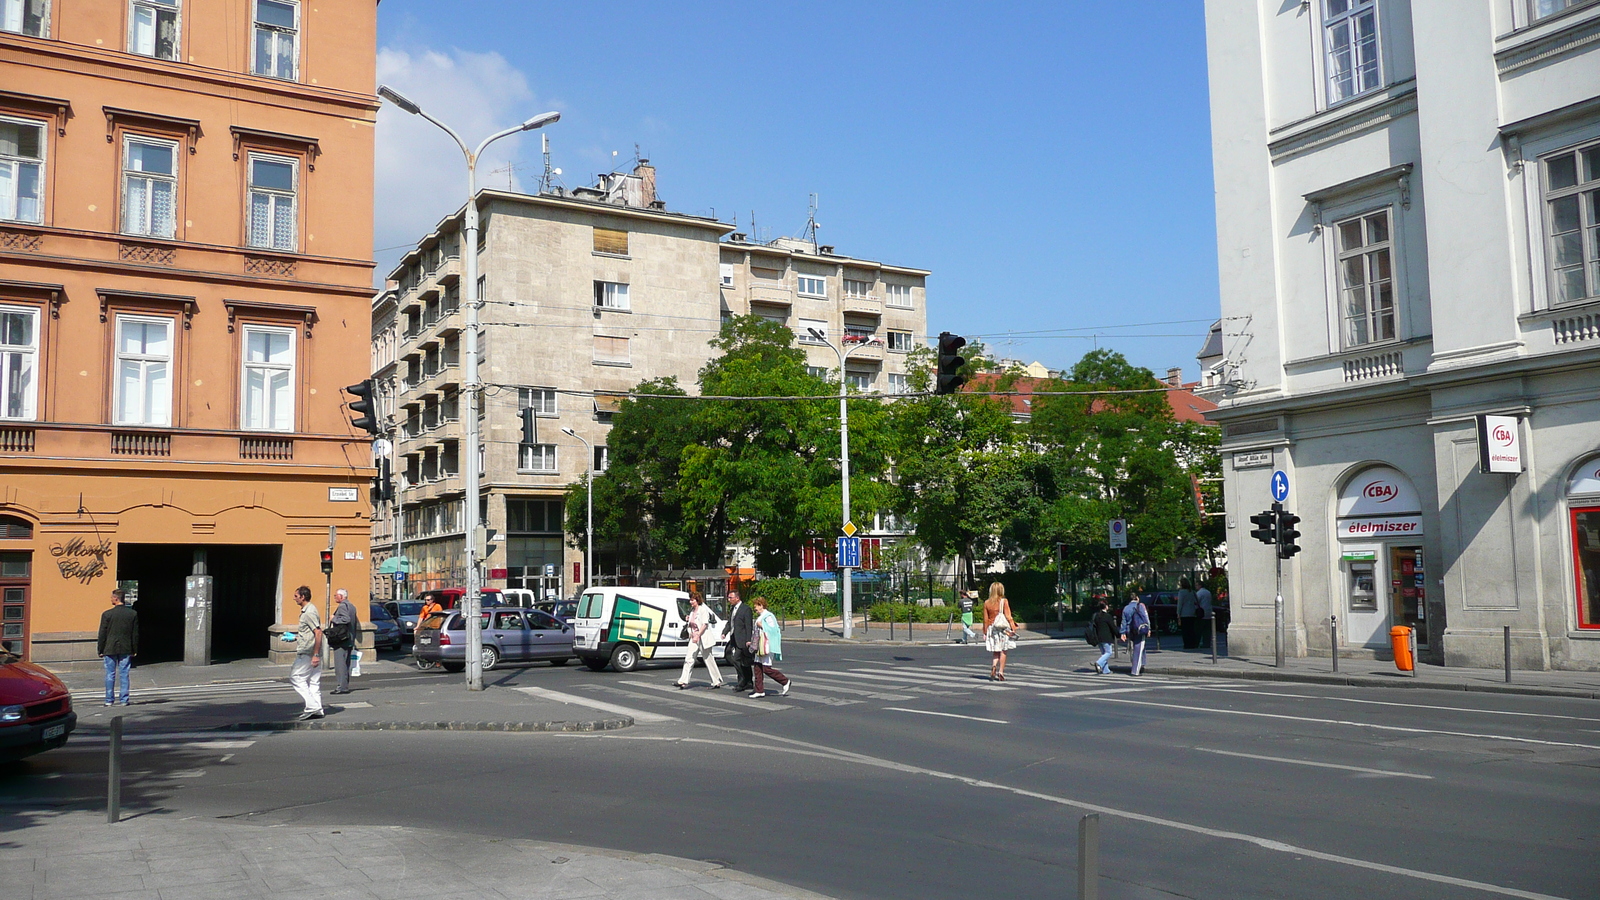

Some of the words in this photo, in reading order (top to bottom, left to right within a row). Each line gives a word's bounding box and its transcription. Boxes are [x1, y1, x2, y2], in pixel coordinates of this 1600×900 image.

[1495, 429, 1511, 441] CBA
[1491, 453, 1518, 462] élelmiszer
[1368, 485, 1392, 498] CBA
[1348, 520, 1417, 533] élelmiszer
